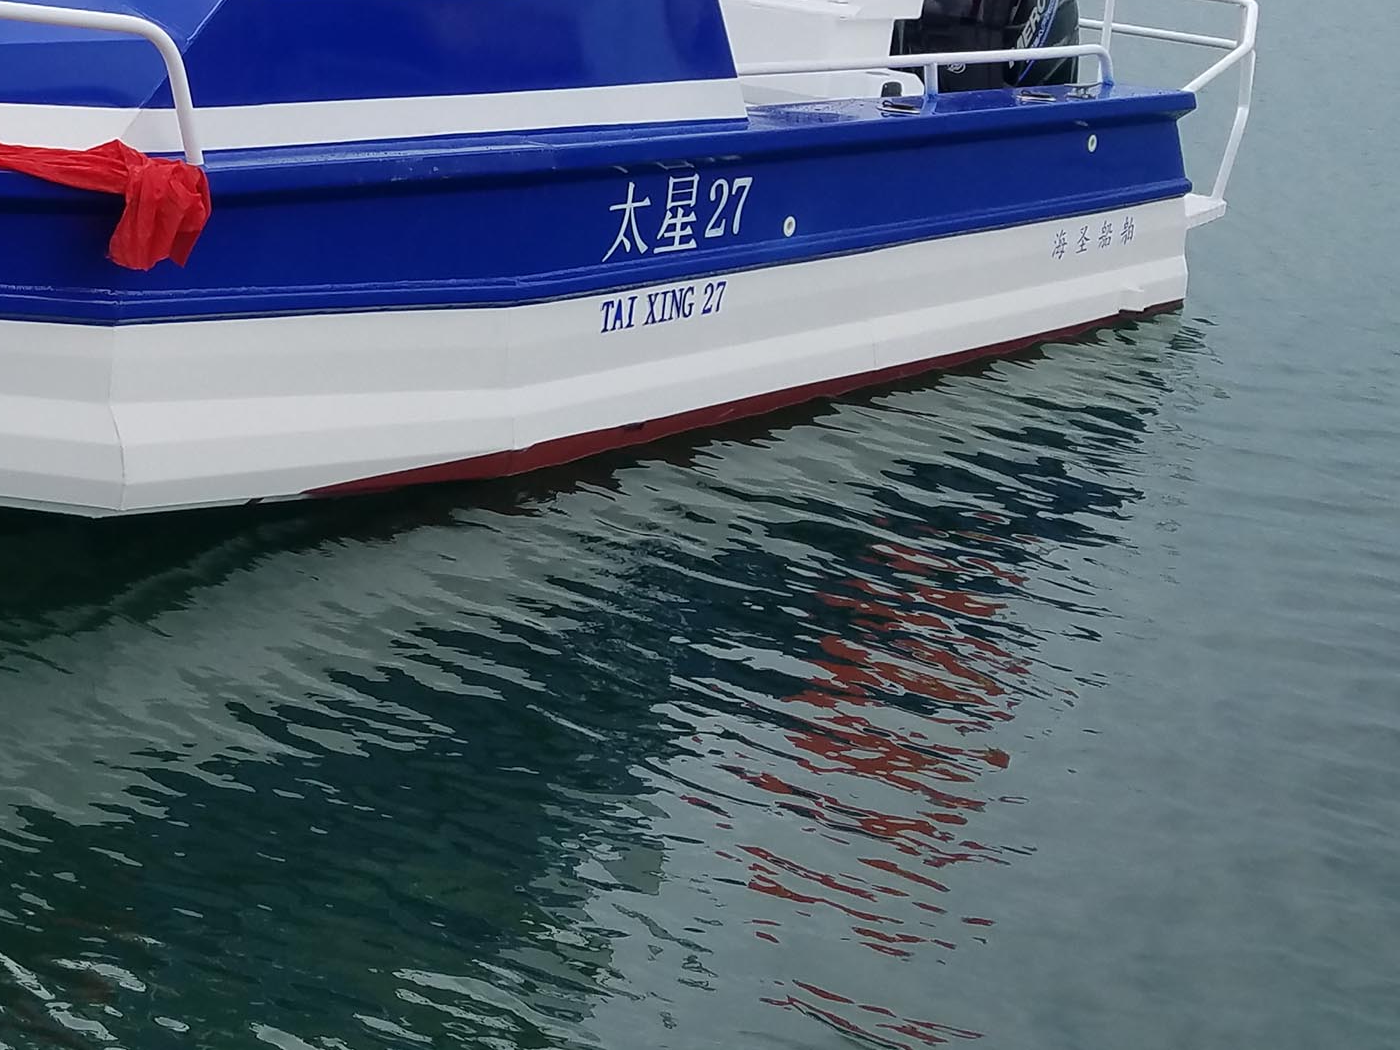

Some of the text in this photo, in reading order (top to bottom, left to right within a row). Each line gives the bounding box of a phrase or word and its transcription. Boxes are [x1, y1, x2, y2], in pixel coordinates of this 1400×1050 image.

[600, 281, 727, 334] TAI XING 27
